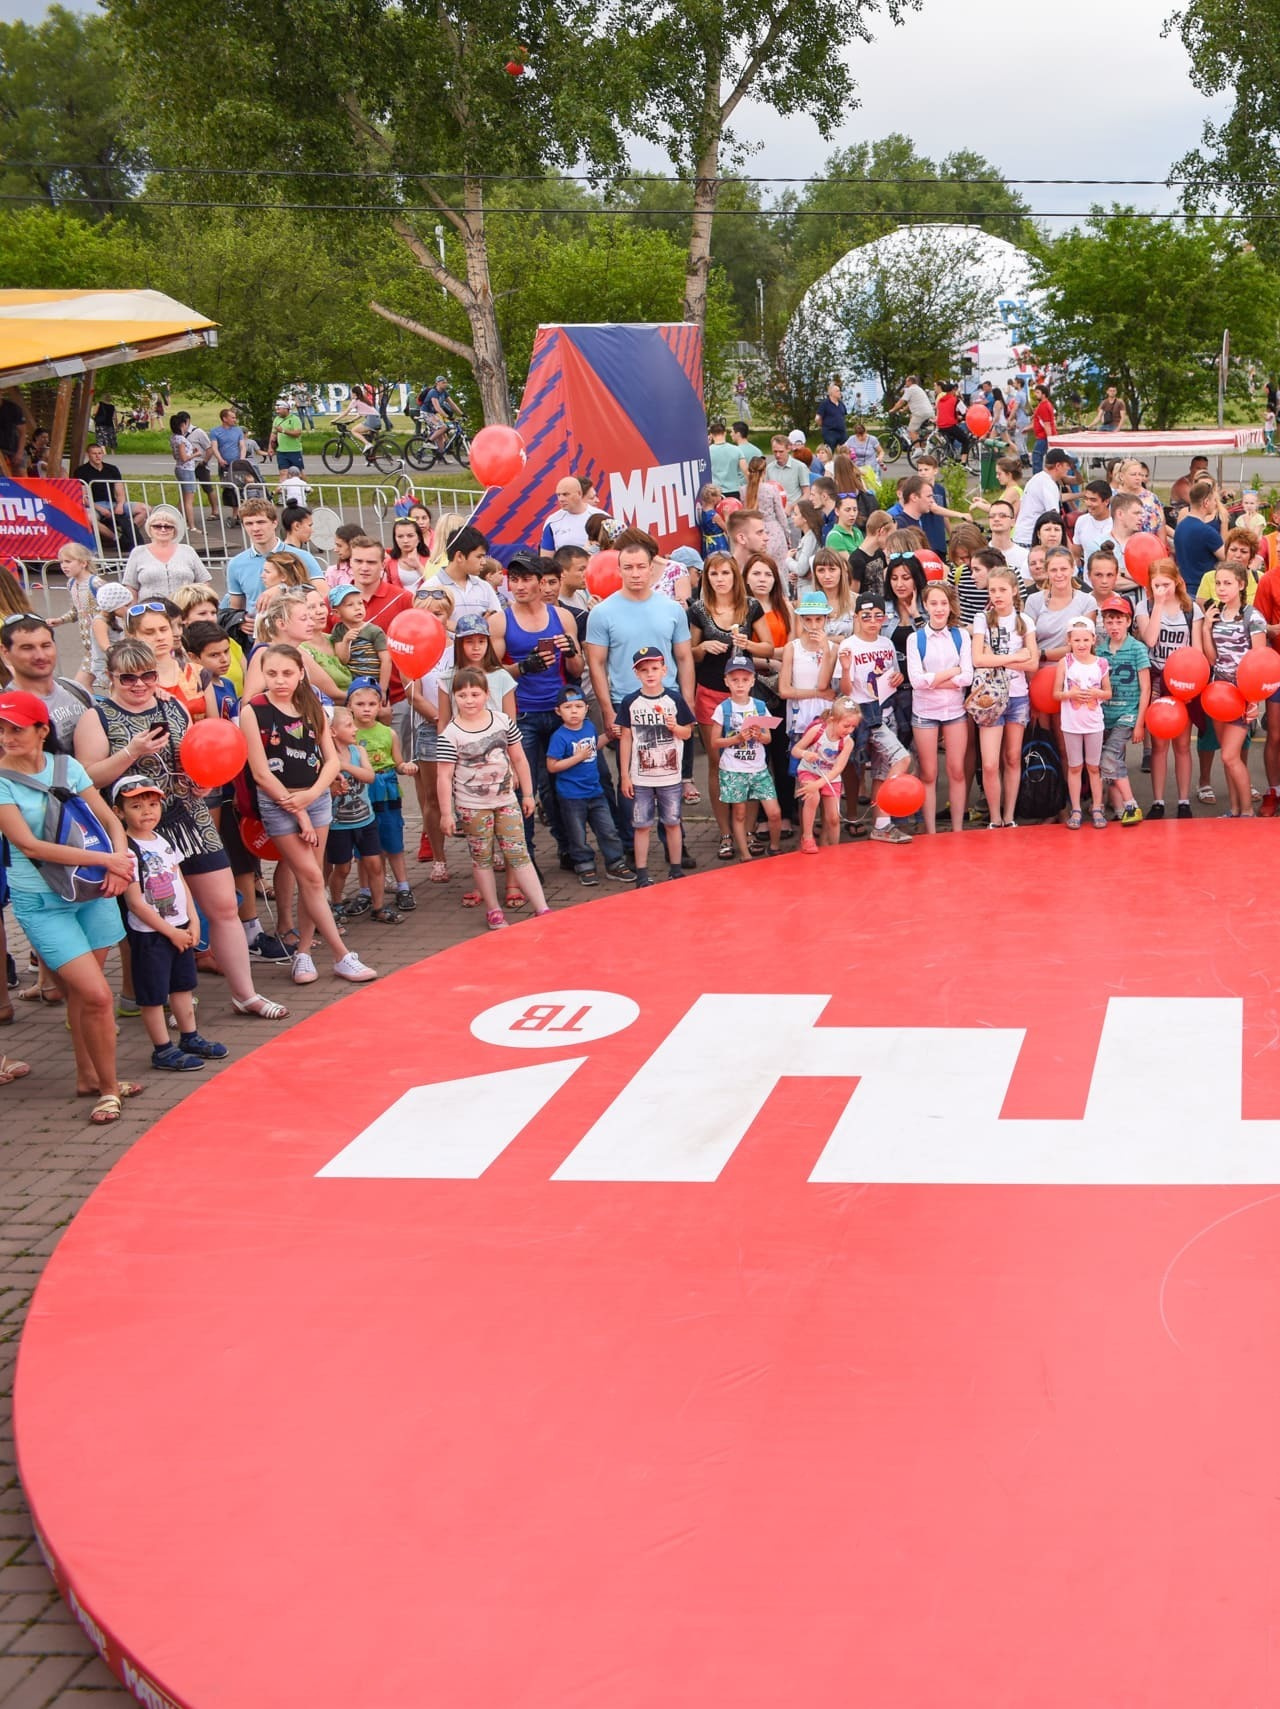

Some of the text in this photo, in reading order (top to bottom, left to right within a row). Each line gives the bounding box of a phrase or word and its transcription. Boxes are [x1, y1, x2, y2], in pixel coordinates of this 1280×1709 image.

[0, 497, 46, 522] ТЧ!
[1160, 629, 1185, 644] OOD
[1153, 645, 1178, 659] LUC
[634, 712, 673, 726] STRE
